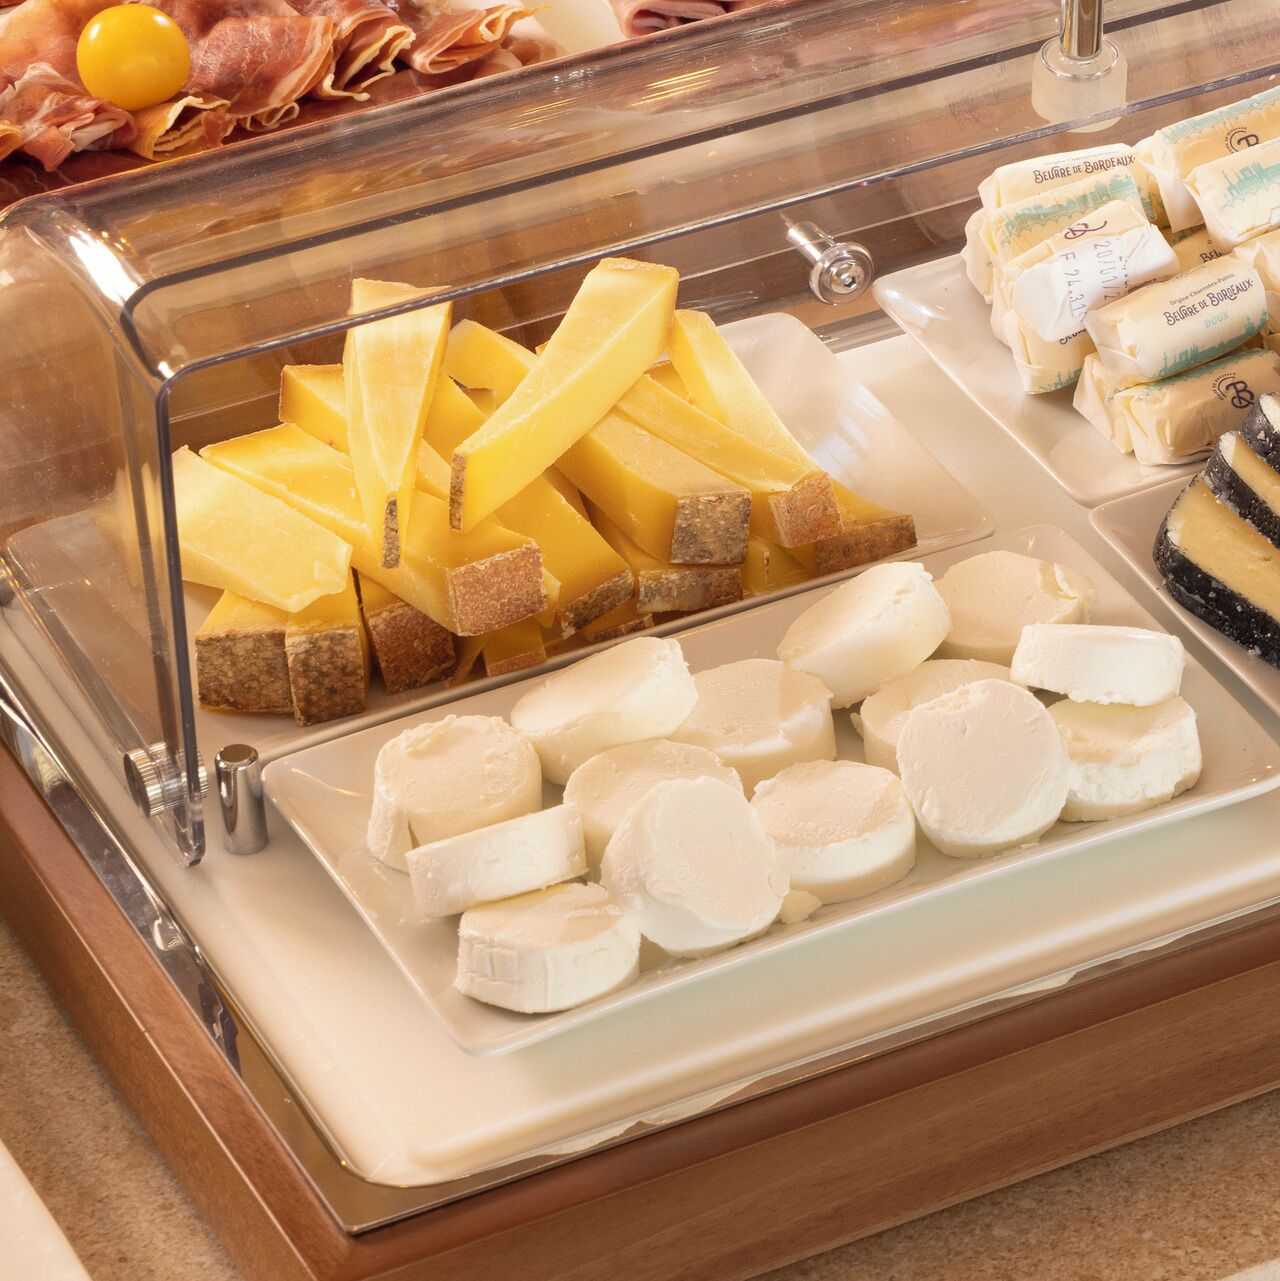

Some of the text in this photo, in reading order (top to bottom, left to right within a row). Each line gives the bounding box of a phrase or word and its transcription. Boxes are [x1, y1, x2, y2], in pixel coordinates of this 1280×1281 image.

[1033, 166, 1072, 184] BEURRE
[1073, 164, 1083, 174] DE
[1163, 305, 1200, 326] BEURRE
[1199, 299, 1209, 310] DE
[1204, 310, 1230, 328] DOUX
